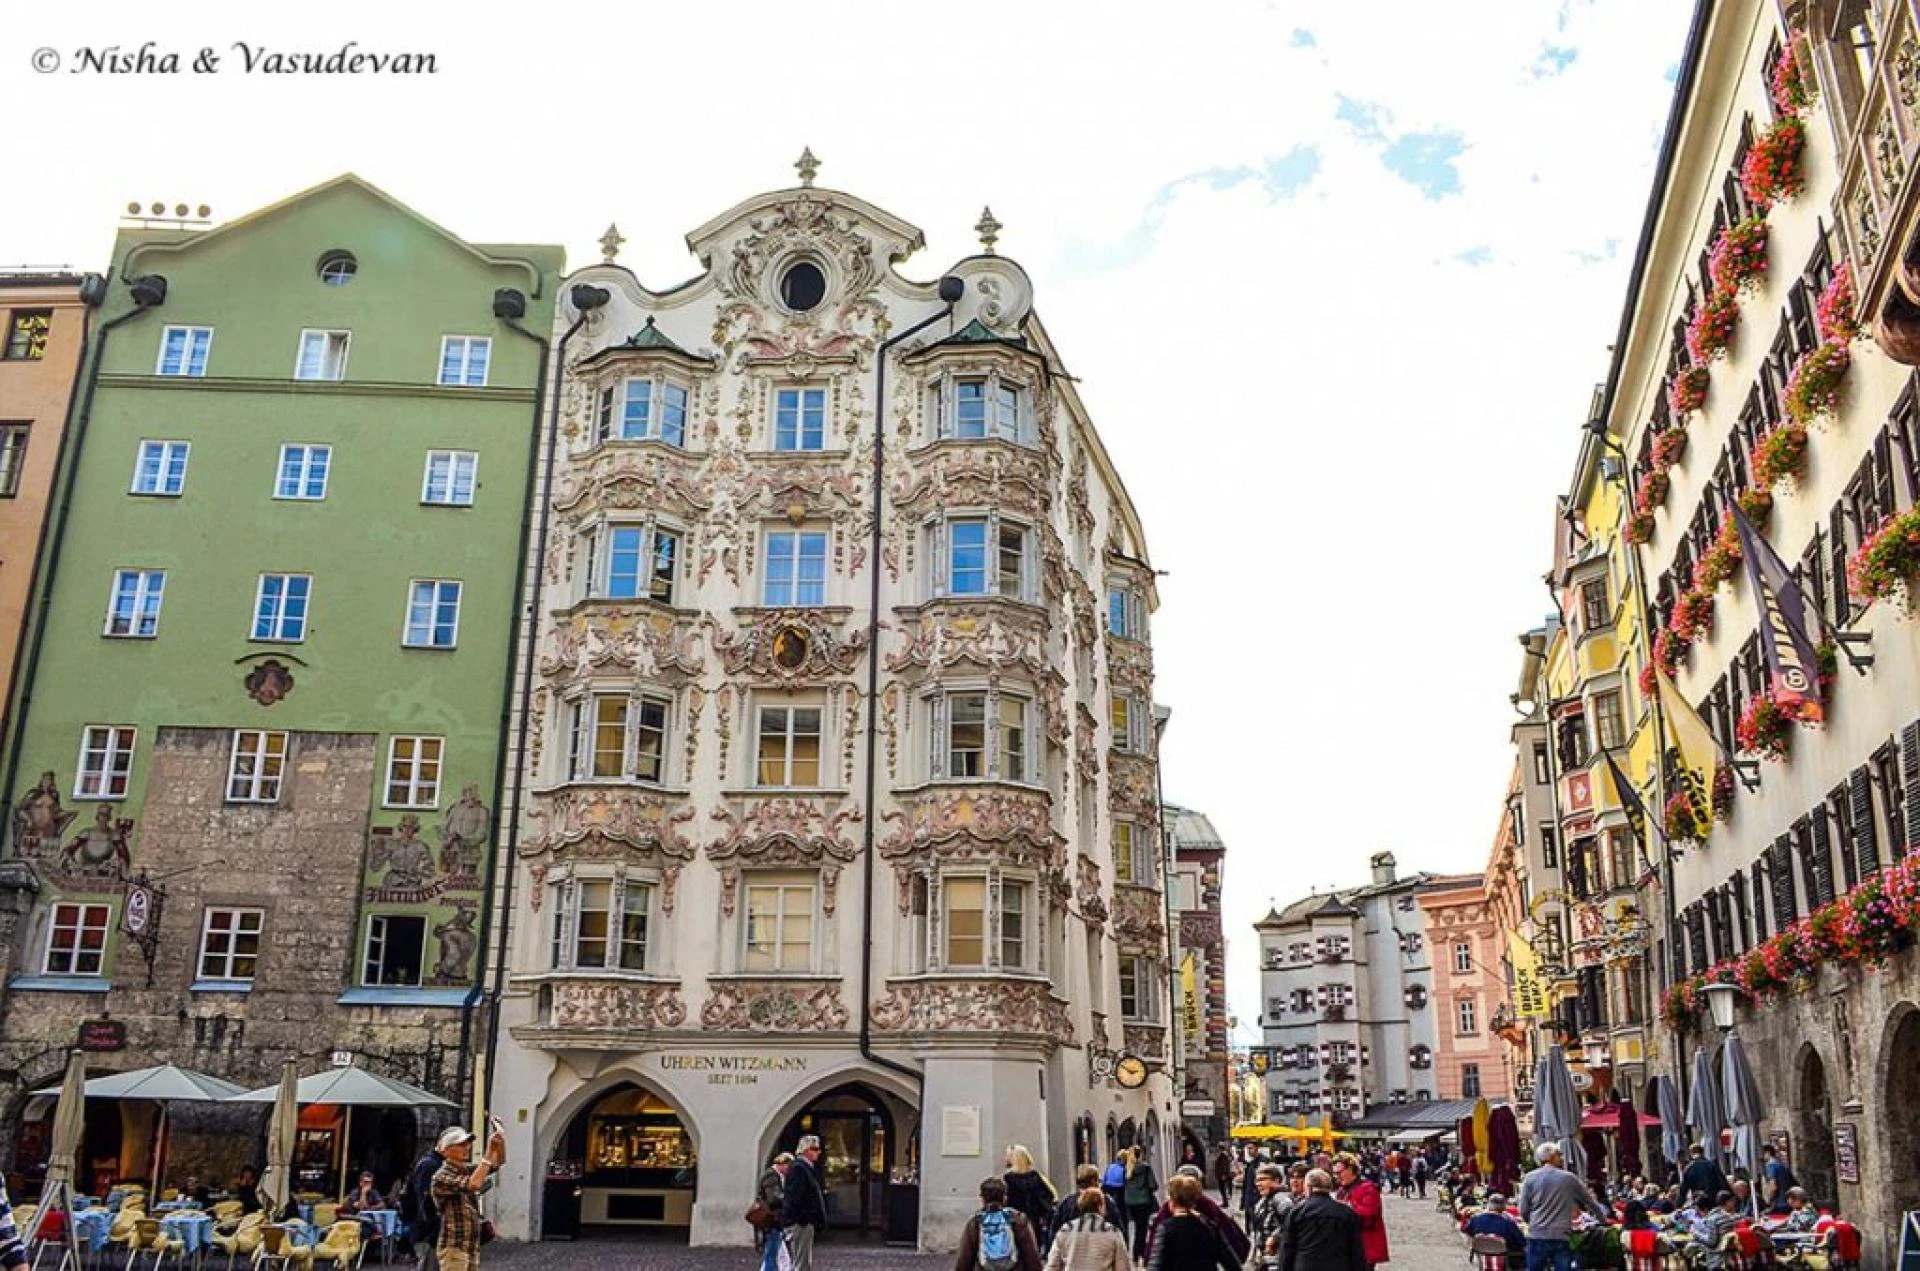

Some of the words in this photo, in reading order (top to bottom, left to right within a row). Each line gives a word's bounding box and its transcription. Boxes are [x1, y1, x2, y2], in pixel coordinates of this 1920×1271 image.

[661, 1055, 716, 1070] UHREN
[719, 1056, 808, 1071] WITZMANN
[708, 1073, 732, 1085] SEIT
